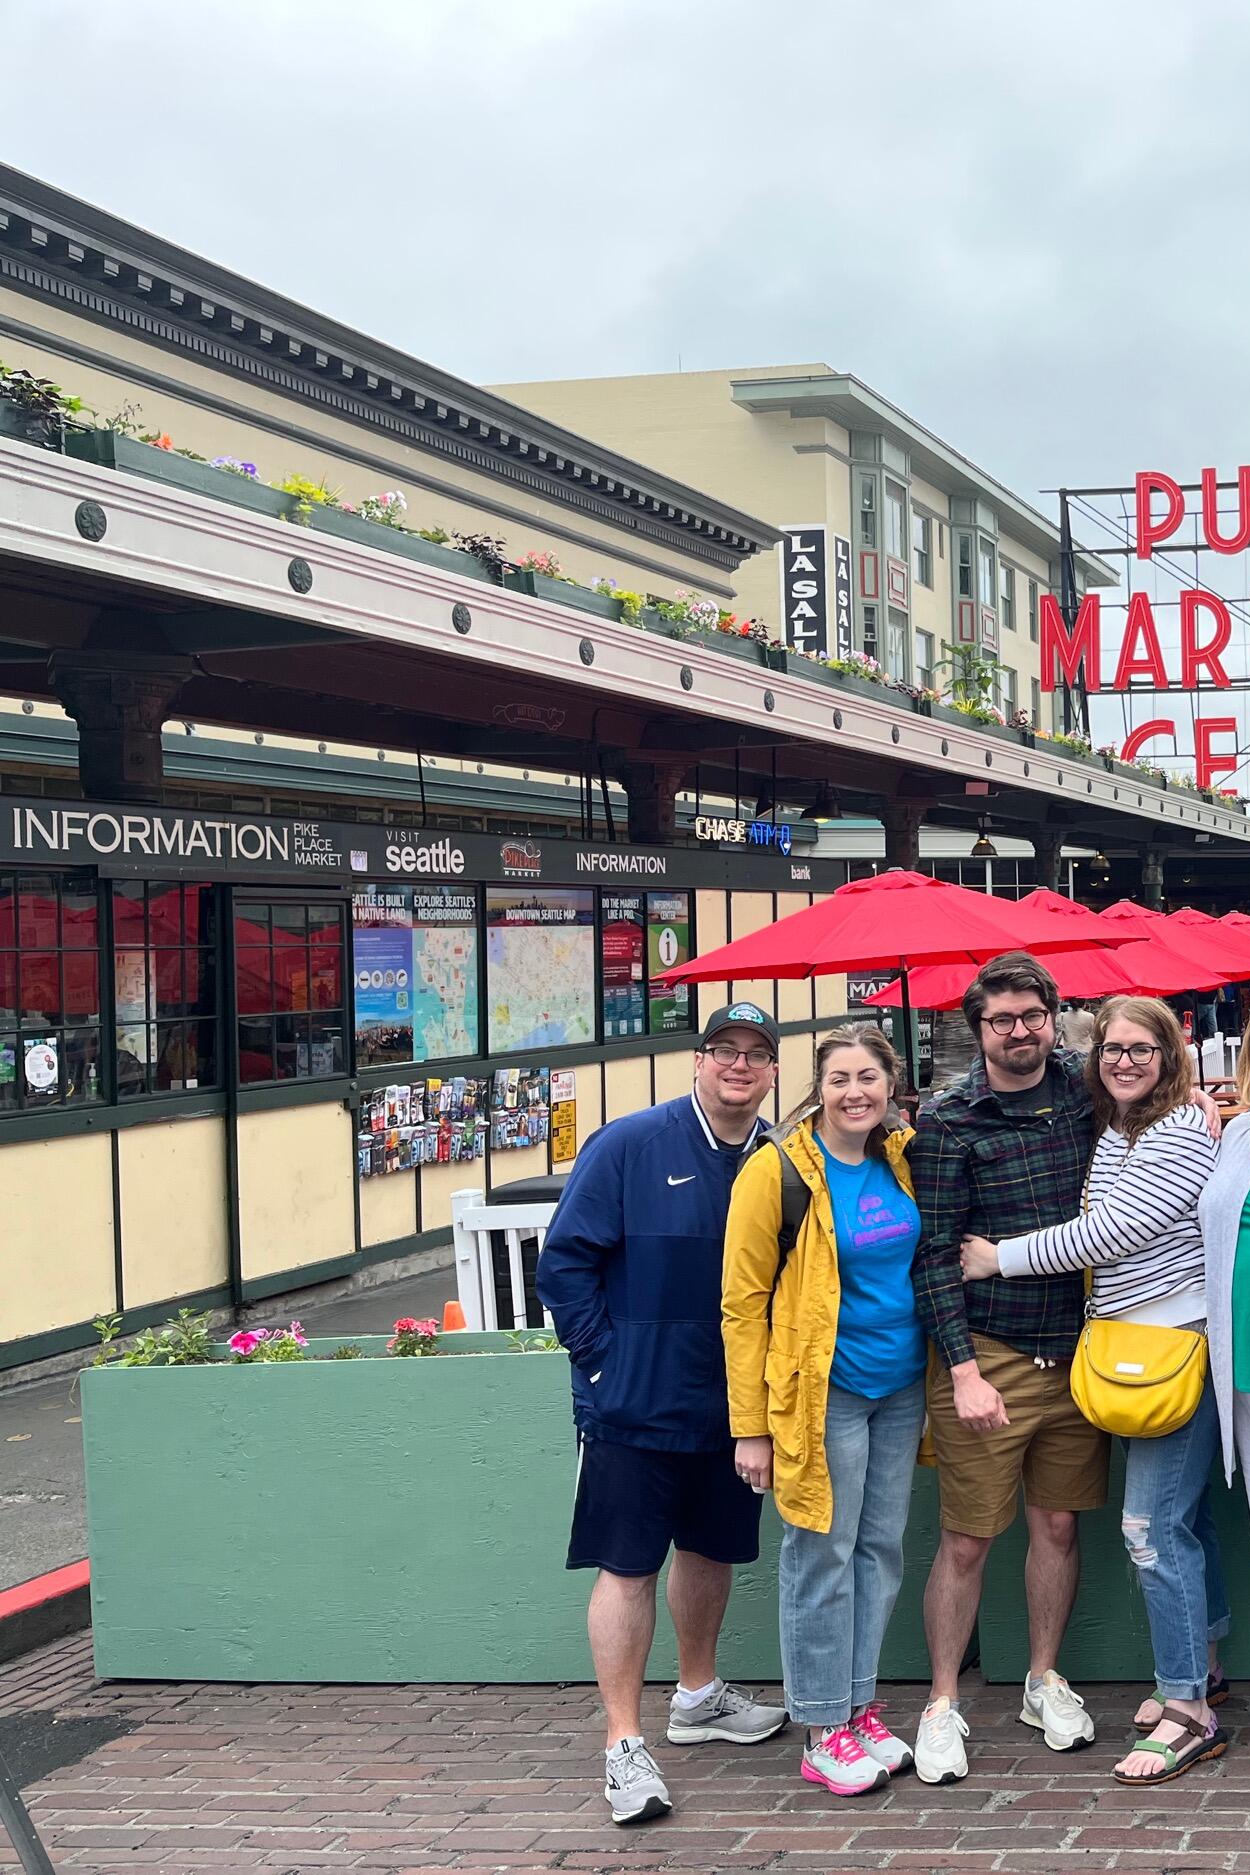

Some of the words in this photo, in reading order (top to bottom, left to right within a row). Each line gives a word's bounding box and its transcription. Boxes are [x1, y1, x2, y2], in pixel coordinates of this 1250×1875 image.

[789, 535, 817, 573] LA
[837, 541, 849, 581] LA
[12, 807, 289, 861] INFORMATION
[293, 822, 320, 837] PIKE
[386, 830, 420, 843] VISIT
[695, 816, 746, 843] CHASE
[749, 822, 777, 846] ATM
[294, 837, 334, 852] PLACE
[295, 852, 343, 866] MARKET
[386, 837, 465, 874] seattle
[576, 852, 666, 874] INFORMATION
[504, 870, 540, 878] MARKET
[790, 864, 811, 880] bank
[378, 894, 385, 906] IS
[386, 894, 405, 907] BUILT
[414, 895, 444, 908] EXPLORE
[445, 896, 476, 908] SEATTLE'S
[601, 898, 609, 909] DO
[610, 898, 619, 909] THE
[620, 898, 639, 909] MARKET
[359, 908, 385, 920] NATIVE
[387, 908, 406, 920] LAND
[417, 908, 473, 920] NEIGHBORHOODS
[506, 908, 540, 921] DOWNTOWN
[541, 909, 562, 921] SEATTLE
[563, 909, 576, 921] MAP
[607, 909, 618, 920] LIKE
